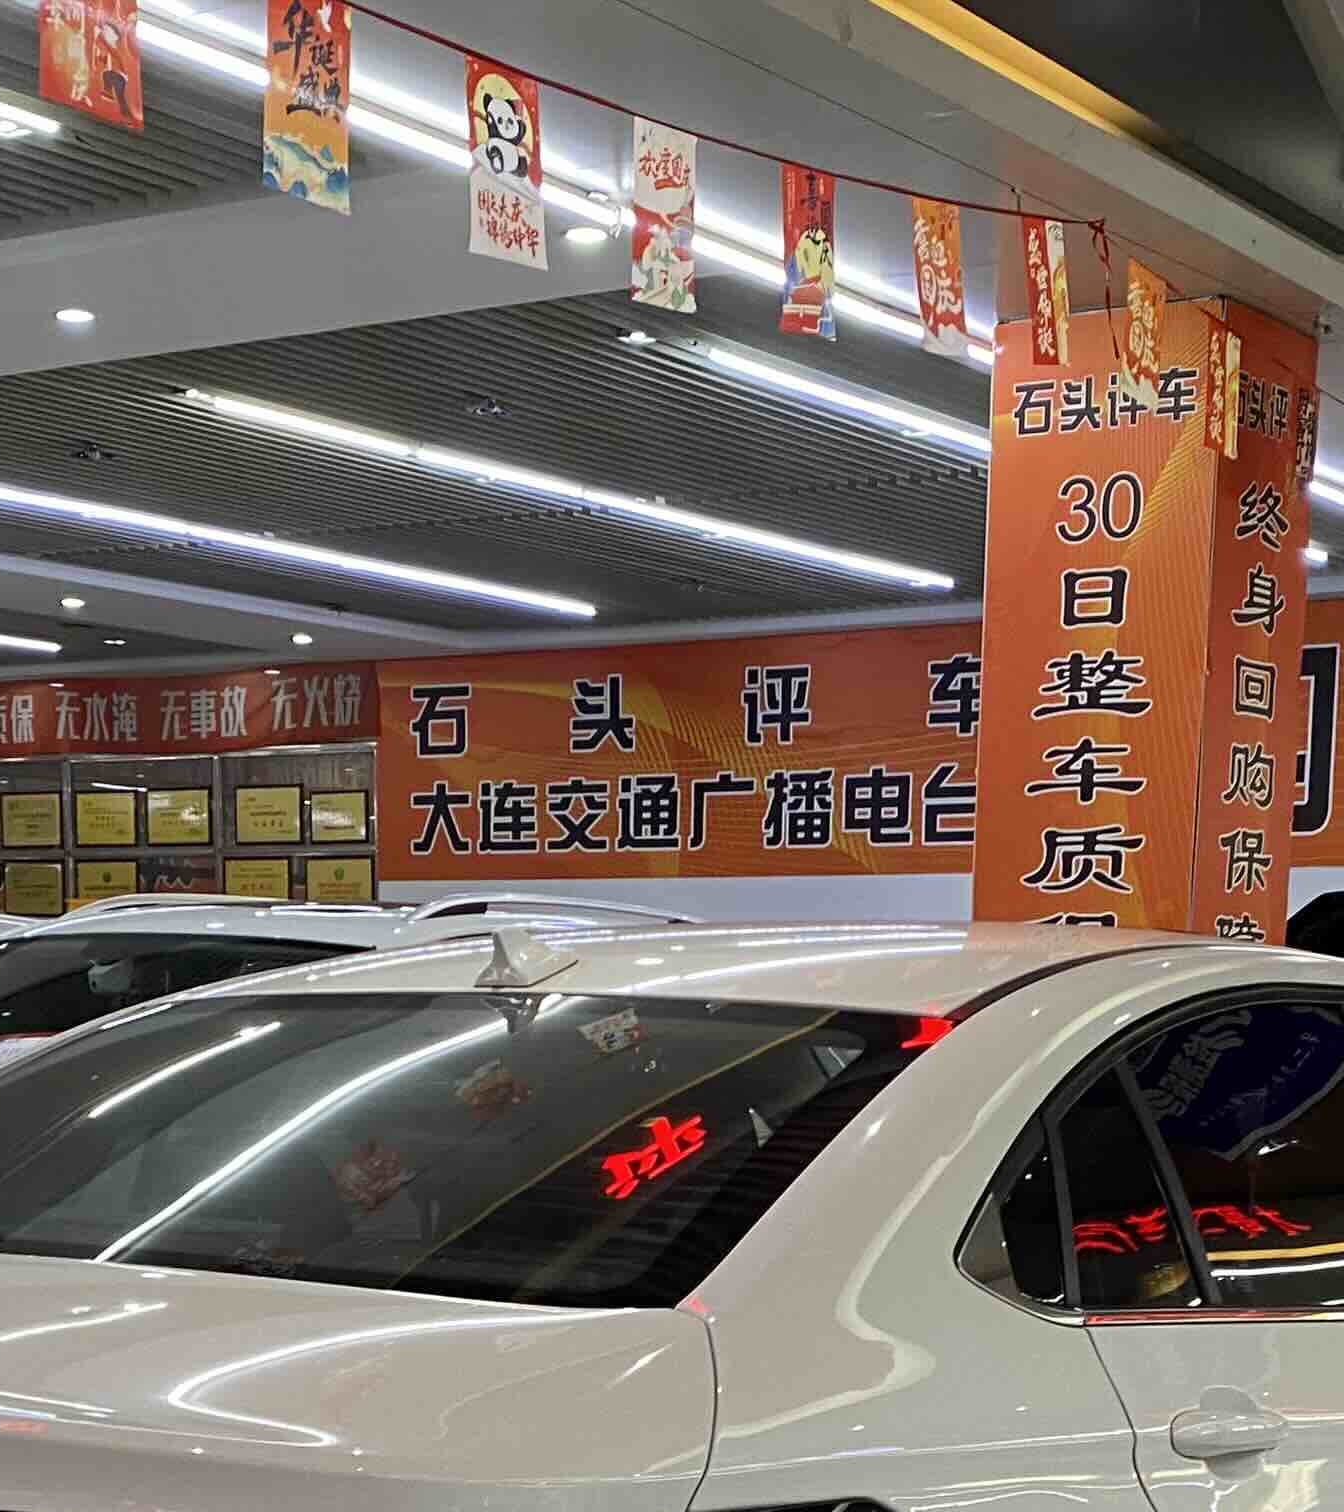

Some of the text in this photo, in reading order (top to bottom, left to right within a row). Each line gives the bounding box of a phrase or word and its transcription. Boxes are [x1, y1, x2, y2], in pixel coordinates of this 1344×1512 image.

[1013, 366, 1199, 437] 石头评车
[55, 689, 141, 743] 无水淹
[159, 684, 249, 743] 无事故
[270, 671, 361, 732] 无火烧
[1019, 470, 1152, 928] 30日整车质
[409, 763, 978, 858] 大连交通广播电台
